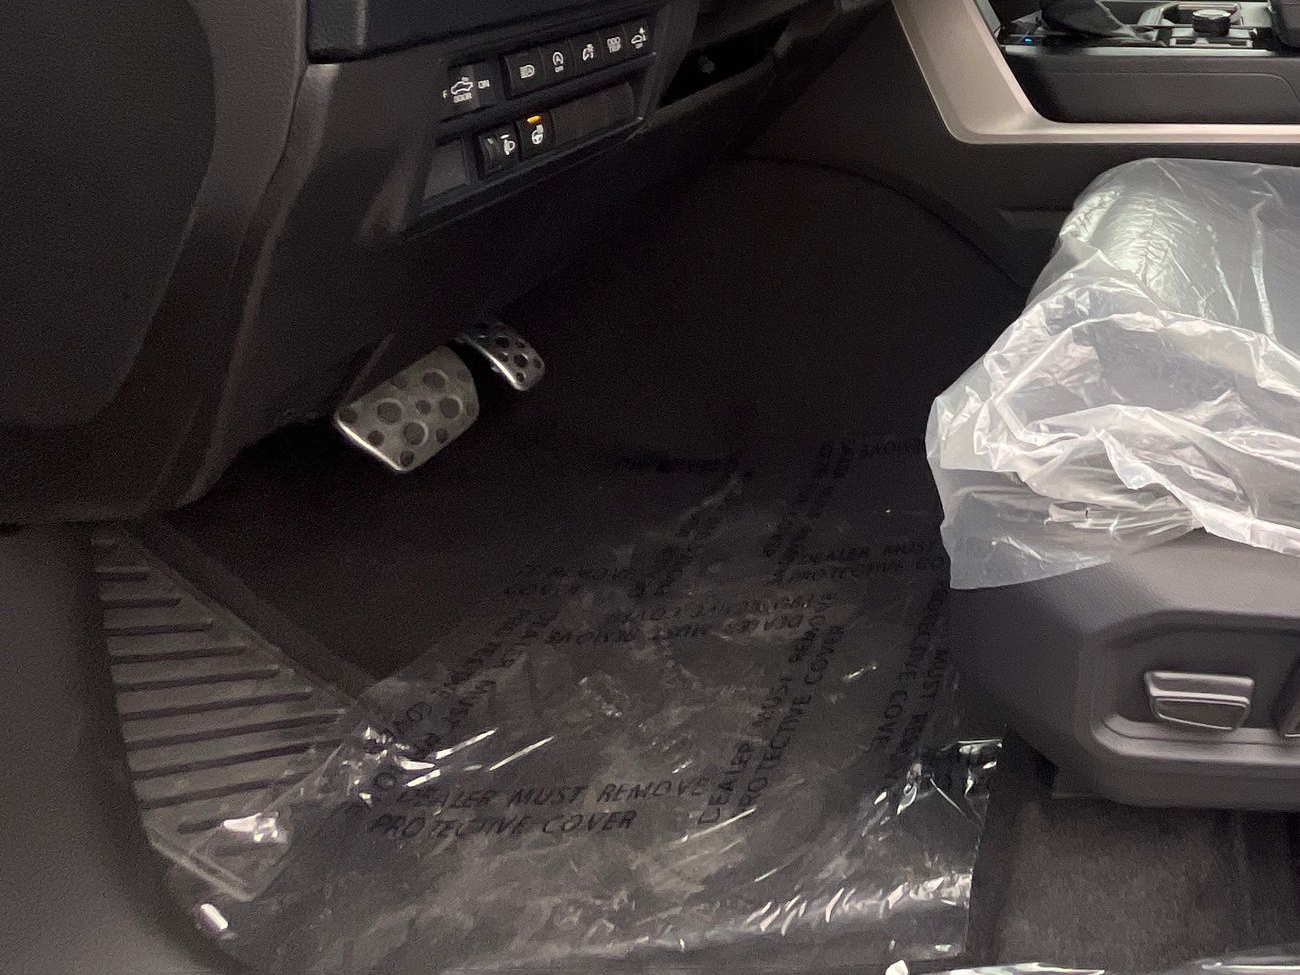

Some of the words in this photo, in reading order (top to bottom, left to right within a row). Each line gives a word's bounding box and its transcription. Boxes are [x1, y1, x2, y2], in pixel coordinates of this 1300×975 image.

[738, 694, 813, 809] ROTECTIVE
[506, 784, 590, 808] MUST
[596, 776, 712, 804] REMOVE
[368, 811, 532, 838] PROTECTIVE
[541, 808, 639, 835] COVER
